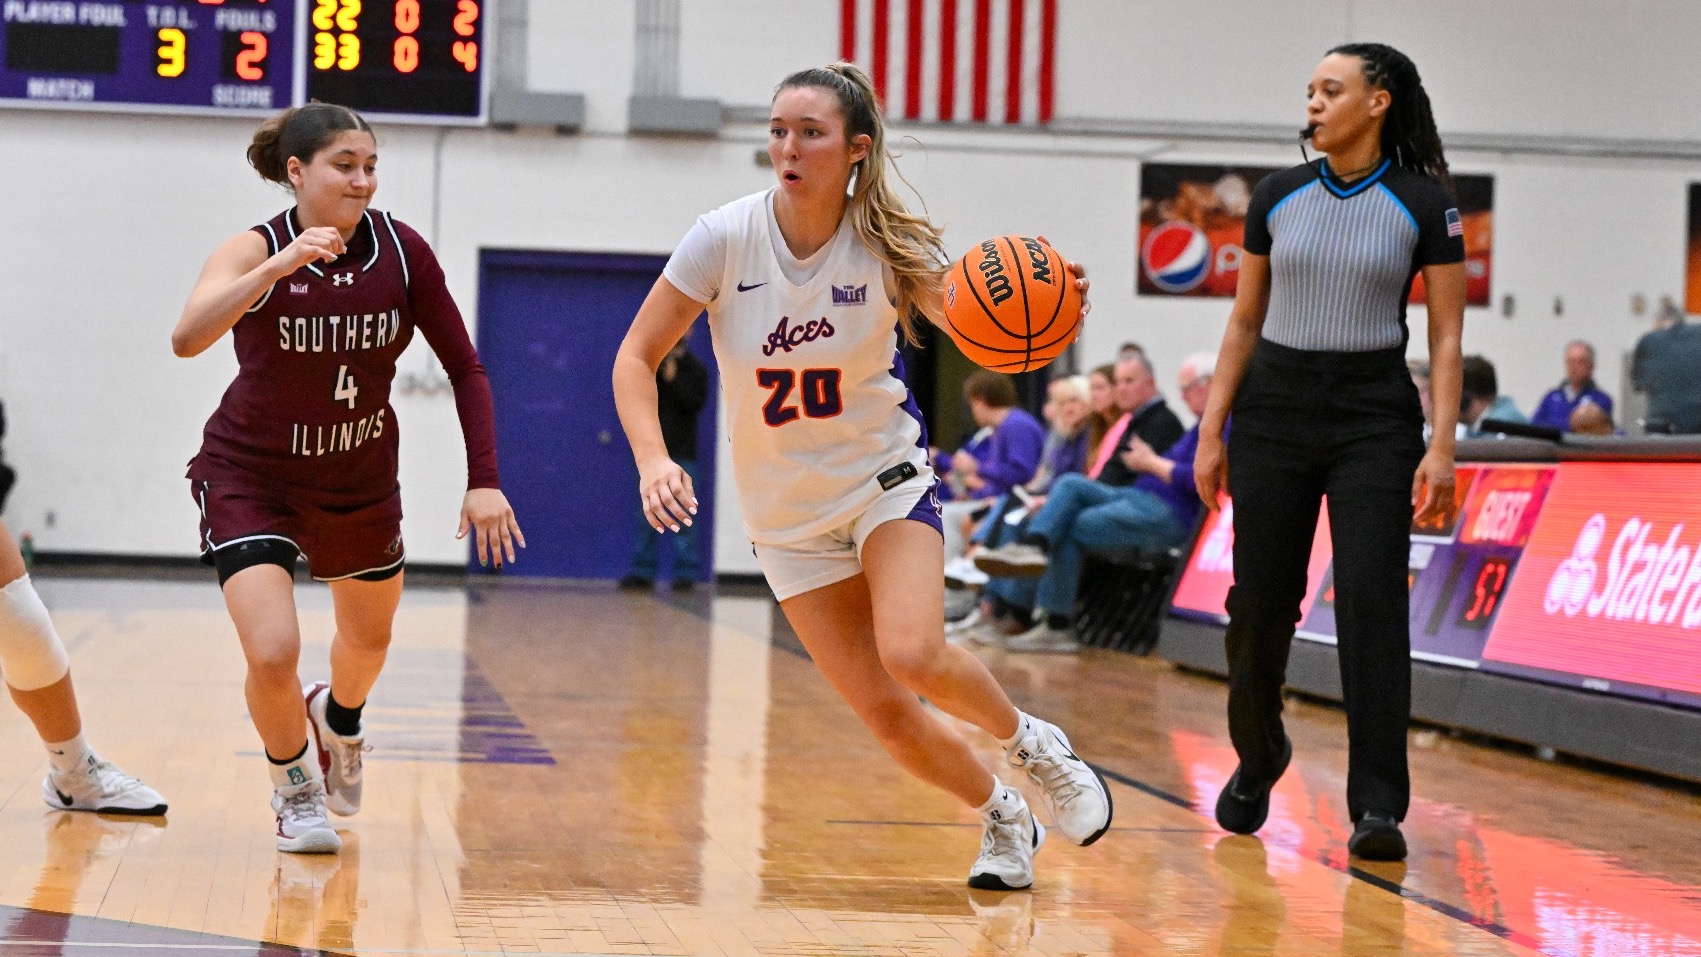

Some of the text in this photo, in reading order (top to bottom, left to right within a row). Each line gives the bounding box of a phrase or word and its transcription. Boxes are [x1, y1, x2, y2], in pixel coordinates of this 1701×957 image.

[4, 1, 127, 27] PLAYER FOUL
[214, 9, 276, 32] FOULS
[312, 0, 479, 36] 22 0 2
[157, 27, 186, 78] 3
[235, 31, 268, 80] 2
[313, 32, 478, 73] 33 0 4
[26, 78, 95, 100] MATCH
[831, 283, 867, 303] VALLEY
[979, 239, 1013, 306] Wilson
[279, 308, 400, 353] SOUTHERN
[762, 316, 835, 357] Aces
[334, 364, 359, 410] 4
[755, 367, 843, 428] 20
[292, 408, 386, 457] ILLINOIS
[1472, 489, 1532, 541] GUEST
